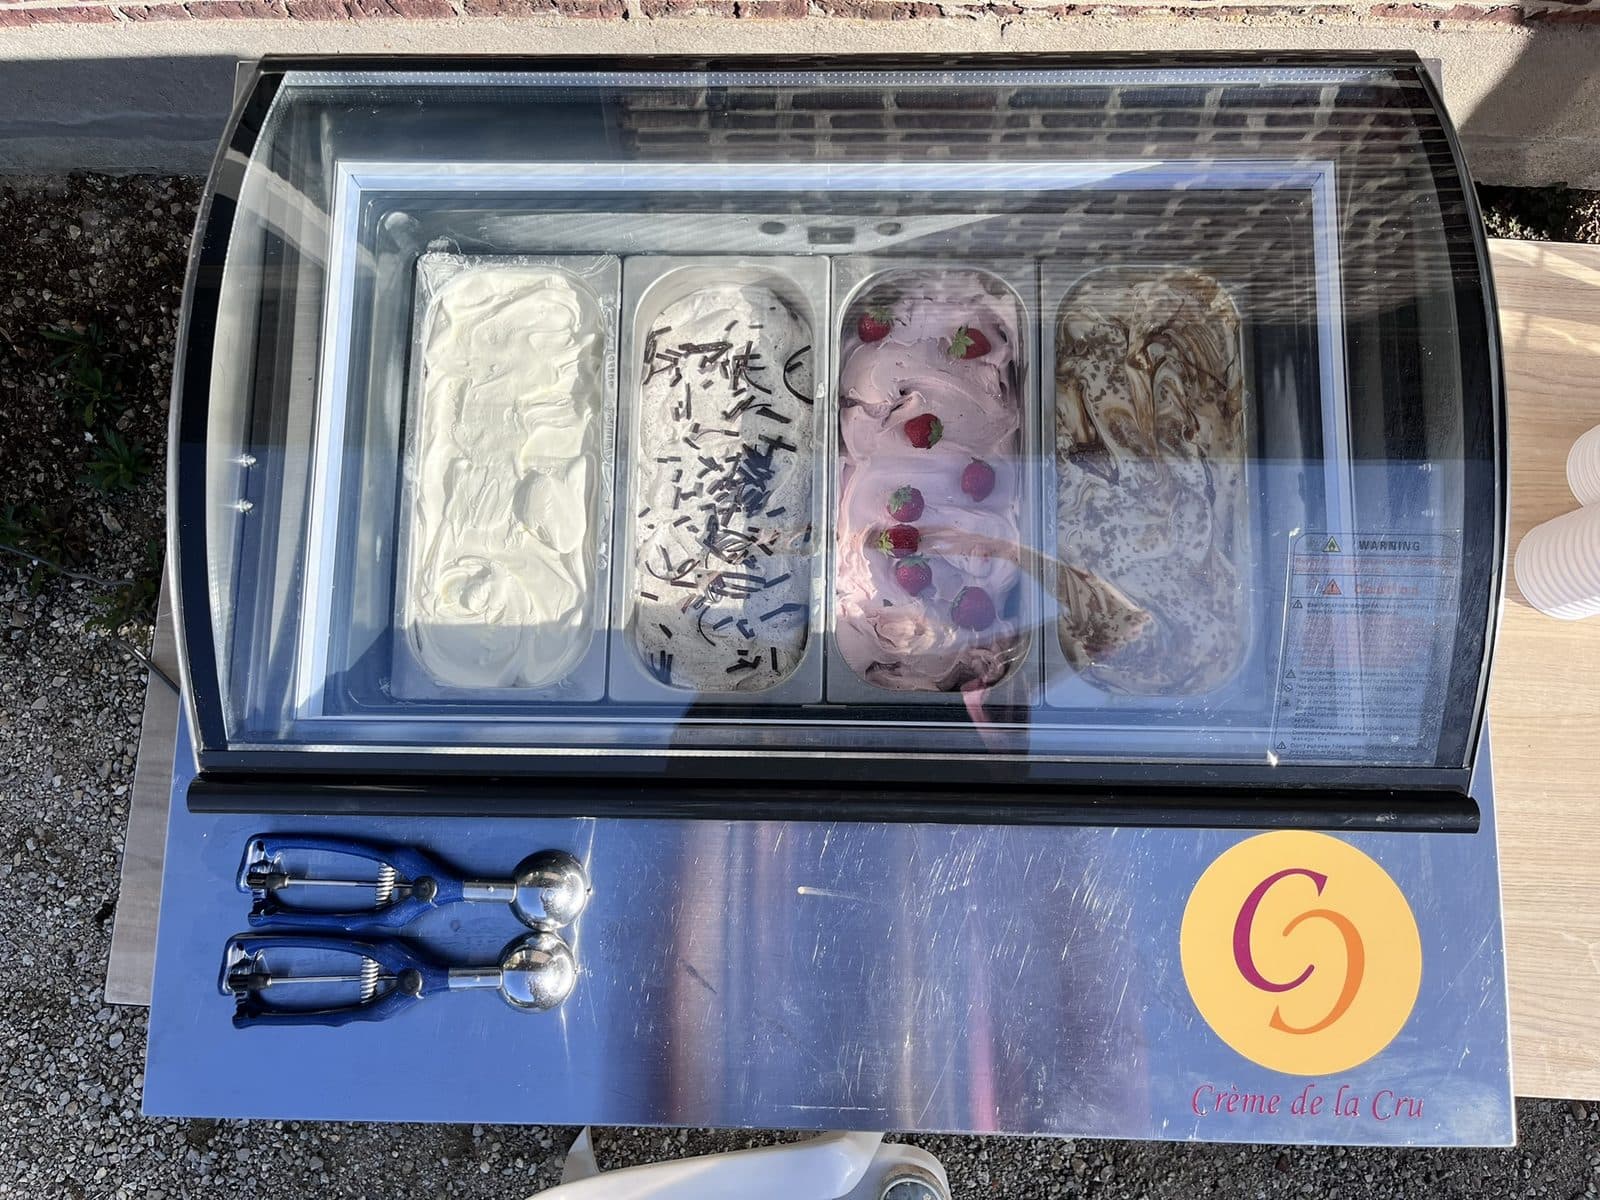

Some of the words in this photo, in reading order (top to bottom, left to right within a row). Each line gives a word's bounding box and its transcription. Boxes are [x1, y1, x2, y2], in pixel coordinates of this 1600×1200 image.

[1358, 540, 1421, 551] WARNING
[1191, 1084, 1281, 1116] Crème
[1291, 1083, 1323, 1116] de
[1334, 1084, 1360, 1117] la
[1371, 1089, 1424, 1121] Cru
